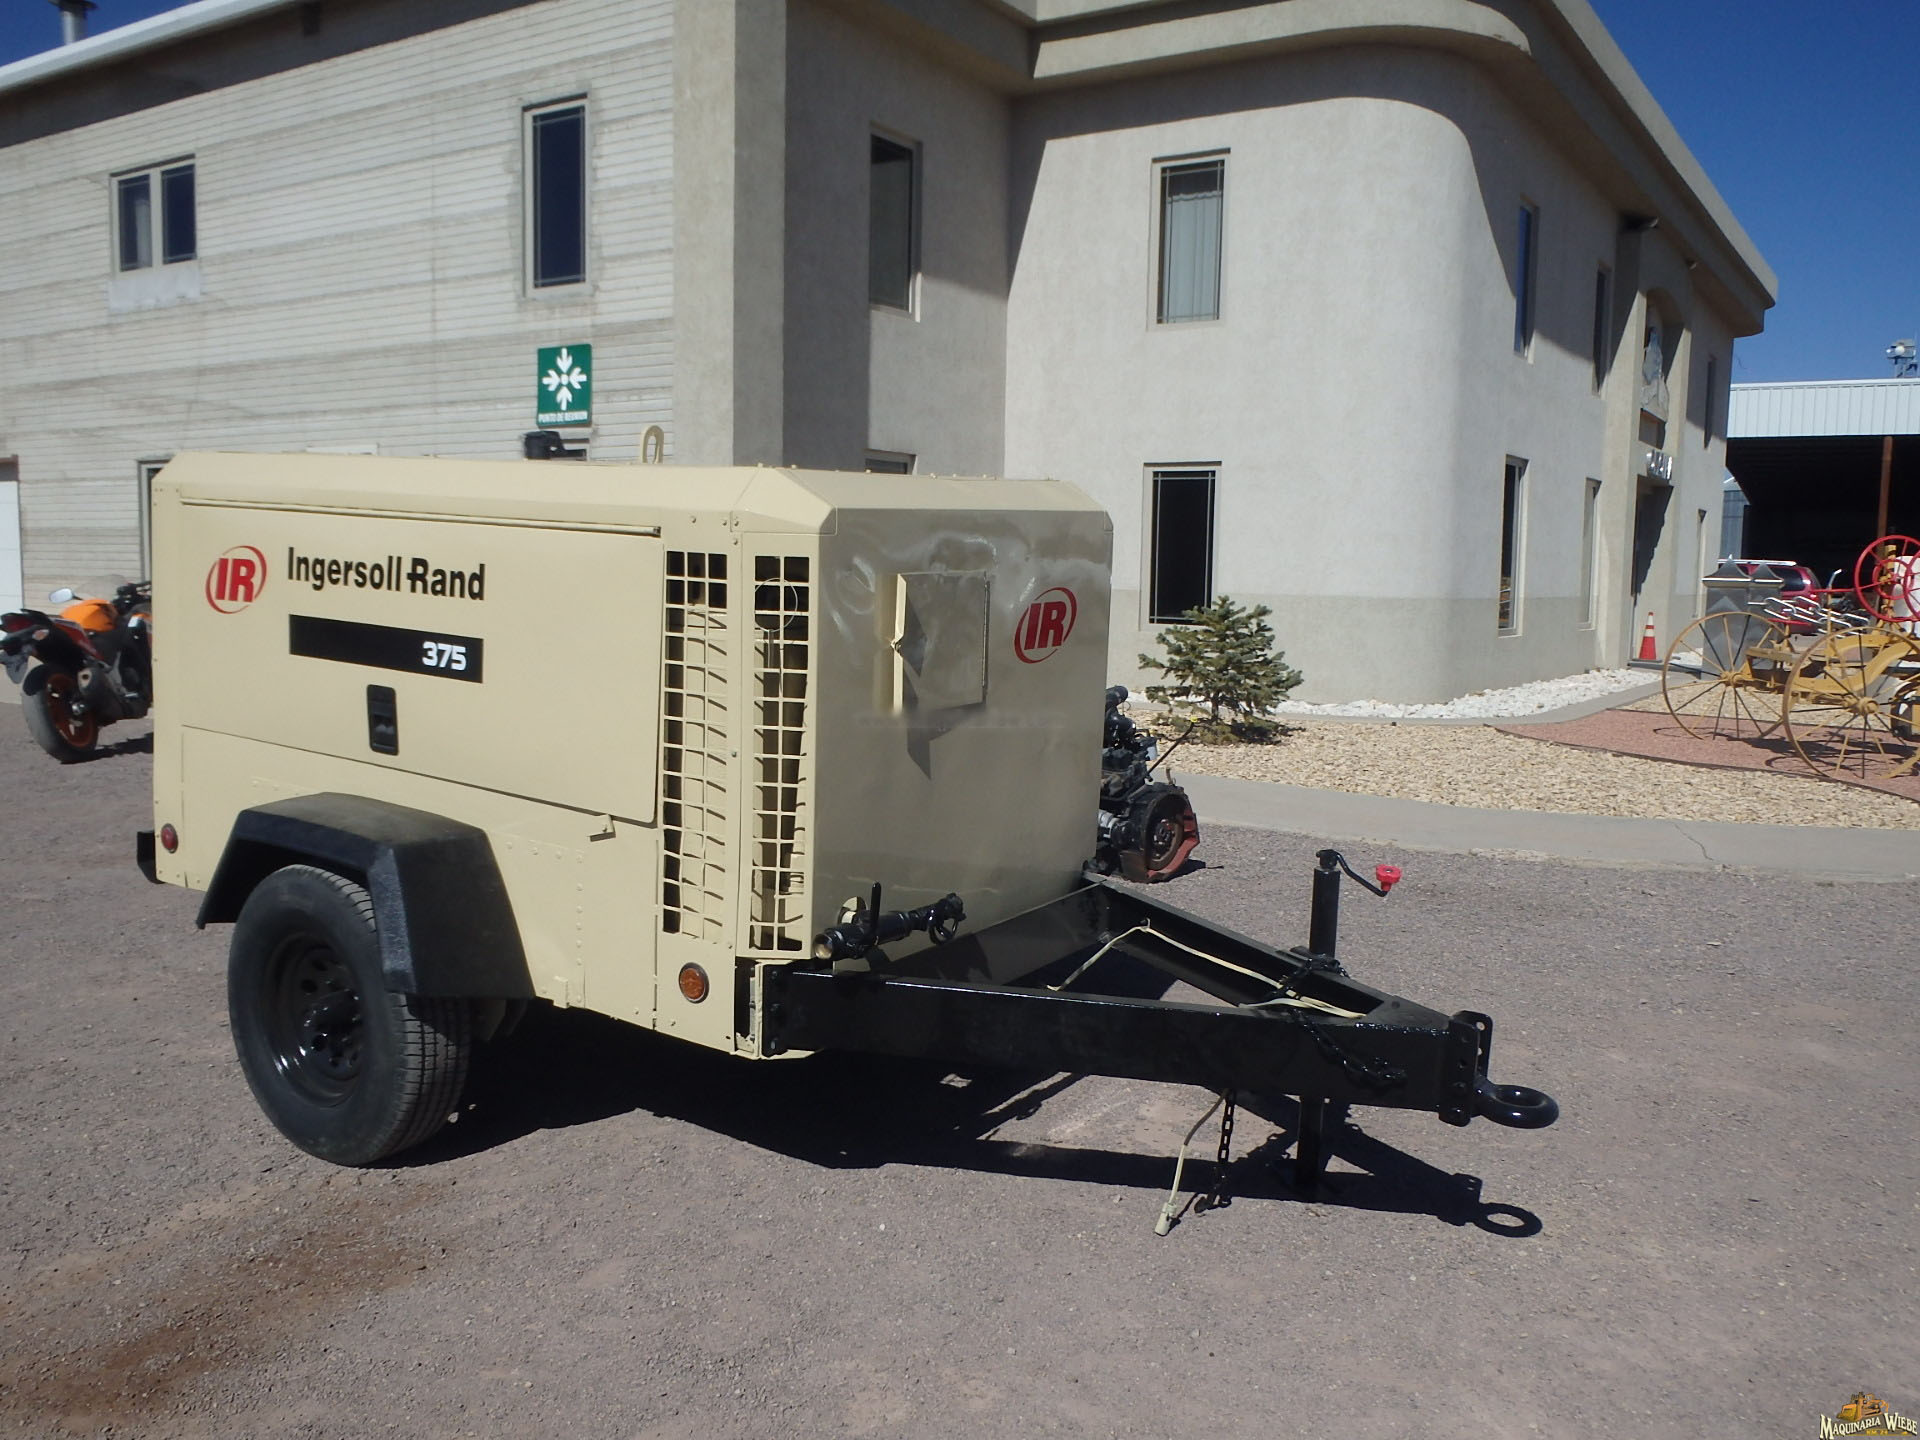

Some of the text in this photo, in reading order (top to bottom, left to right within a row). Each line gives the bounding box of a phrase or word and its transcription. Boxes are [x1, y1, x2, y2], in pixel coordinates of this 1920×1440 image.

[215, 557, 256, 603] IR
[1024, 601, 1067, 651] IR
[422, 641, 467, 671] 375
